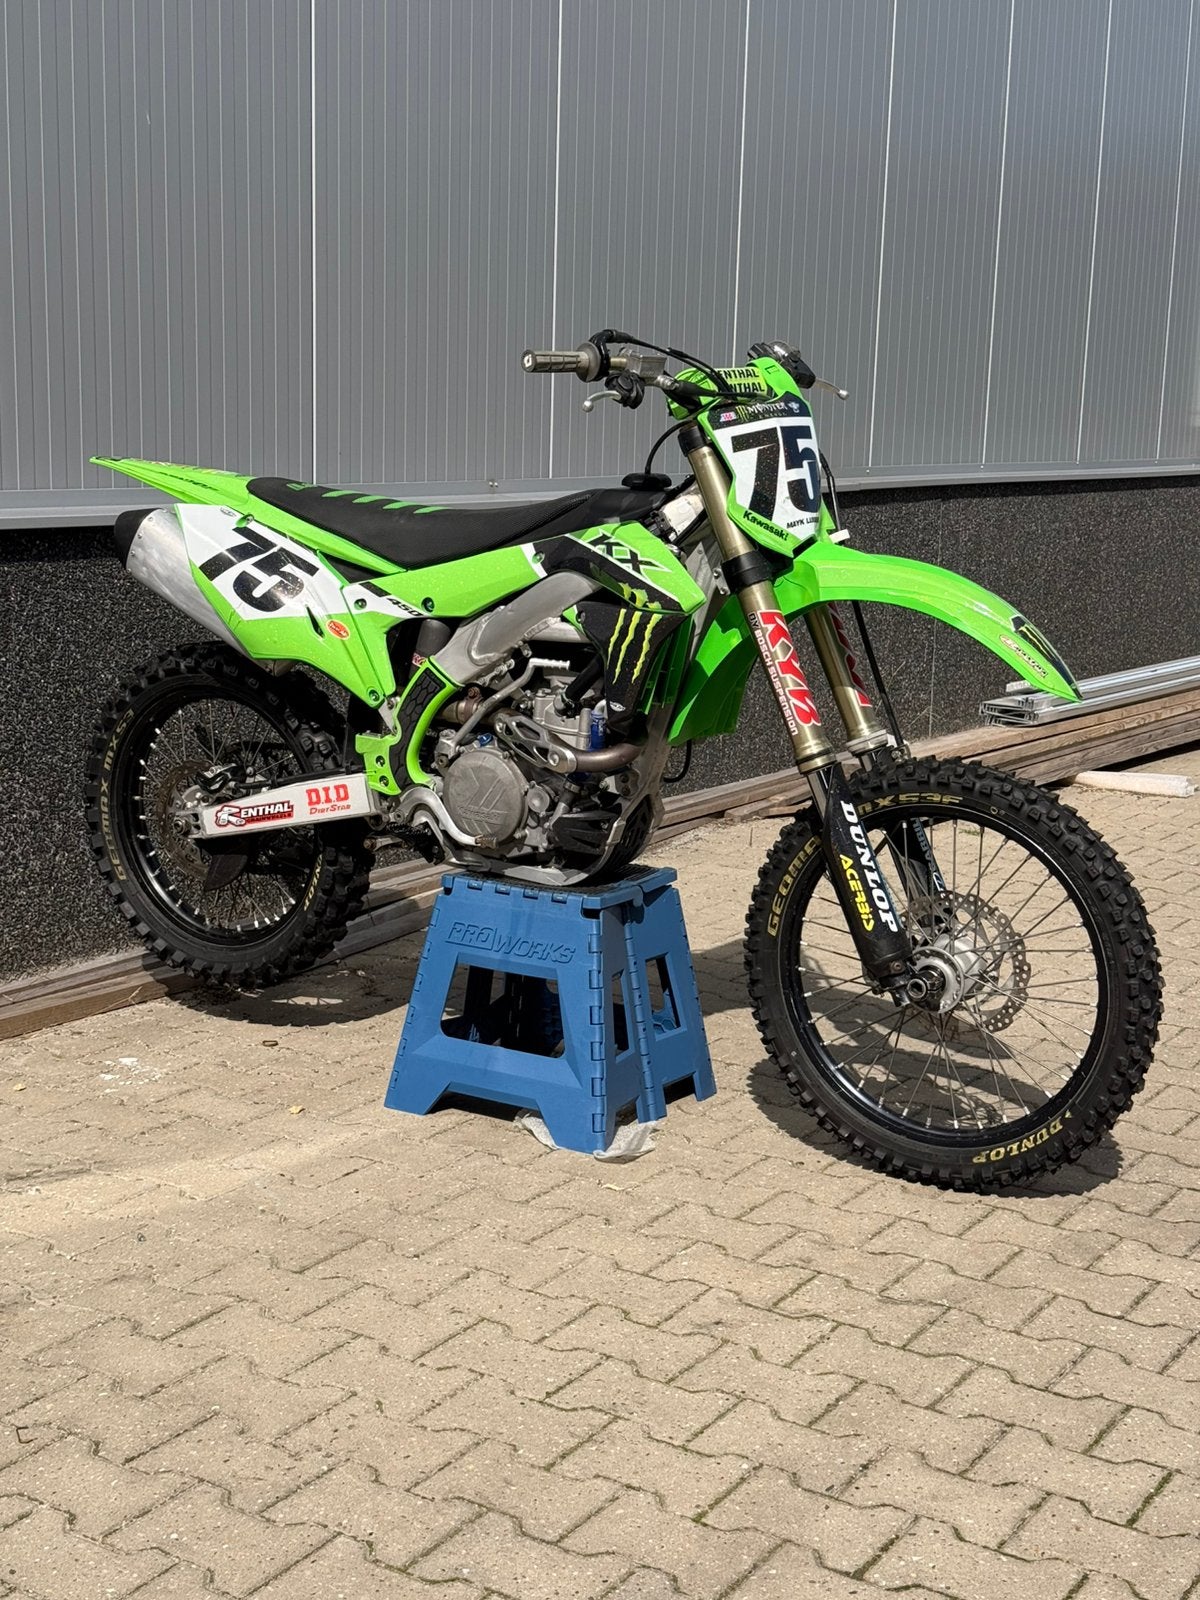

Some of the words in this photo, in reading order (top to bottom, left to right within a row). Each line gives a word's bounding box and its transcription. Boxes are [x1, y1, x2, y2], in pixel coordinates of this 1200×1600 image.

[718, 369, 759, 379] ENTHAL
[730, 382, 765, 393] NTHAL
[731, 425, 821, 522] 75
[743, 510, 789, 541] Kawasaki
[787, 519, 805, 529] MAYK
[199, 525, 319, 612] 75
[588, 529, 672, 578] KX
[387, 598, 424, 617] 450
[748, 612, 760, 629] BY
[755, 629, 772, 666] BOSCH
[768, 666, 799, 736] SUSPENSION
[757, 609, 822, 726] KYB
[216, 802, 293, 827] RENTHAL
[306, 783, 350, 806] D.I.D
[767, 834, 822, 937] GEOMA
[840, 800, 899, 932] DUNLOP
[840, 854, 876, 932] ACERBIS
[972, 1117, 1064, 1164] DUNLOP
